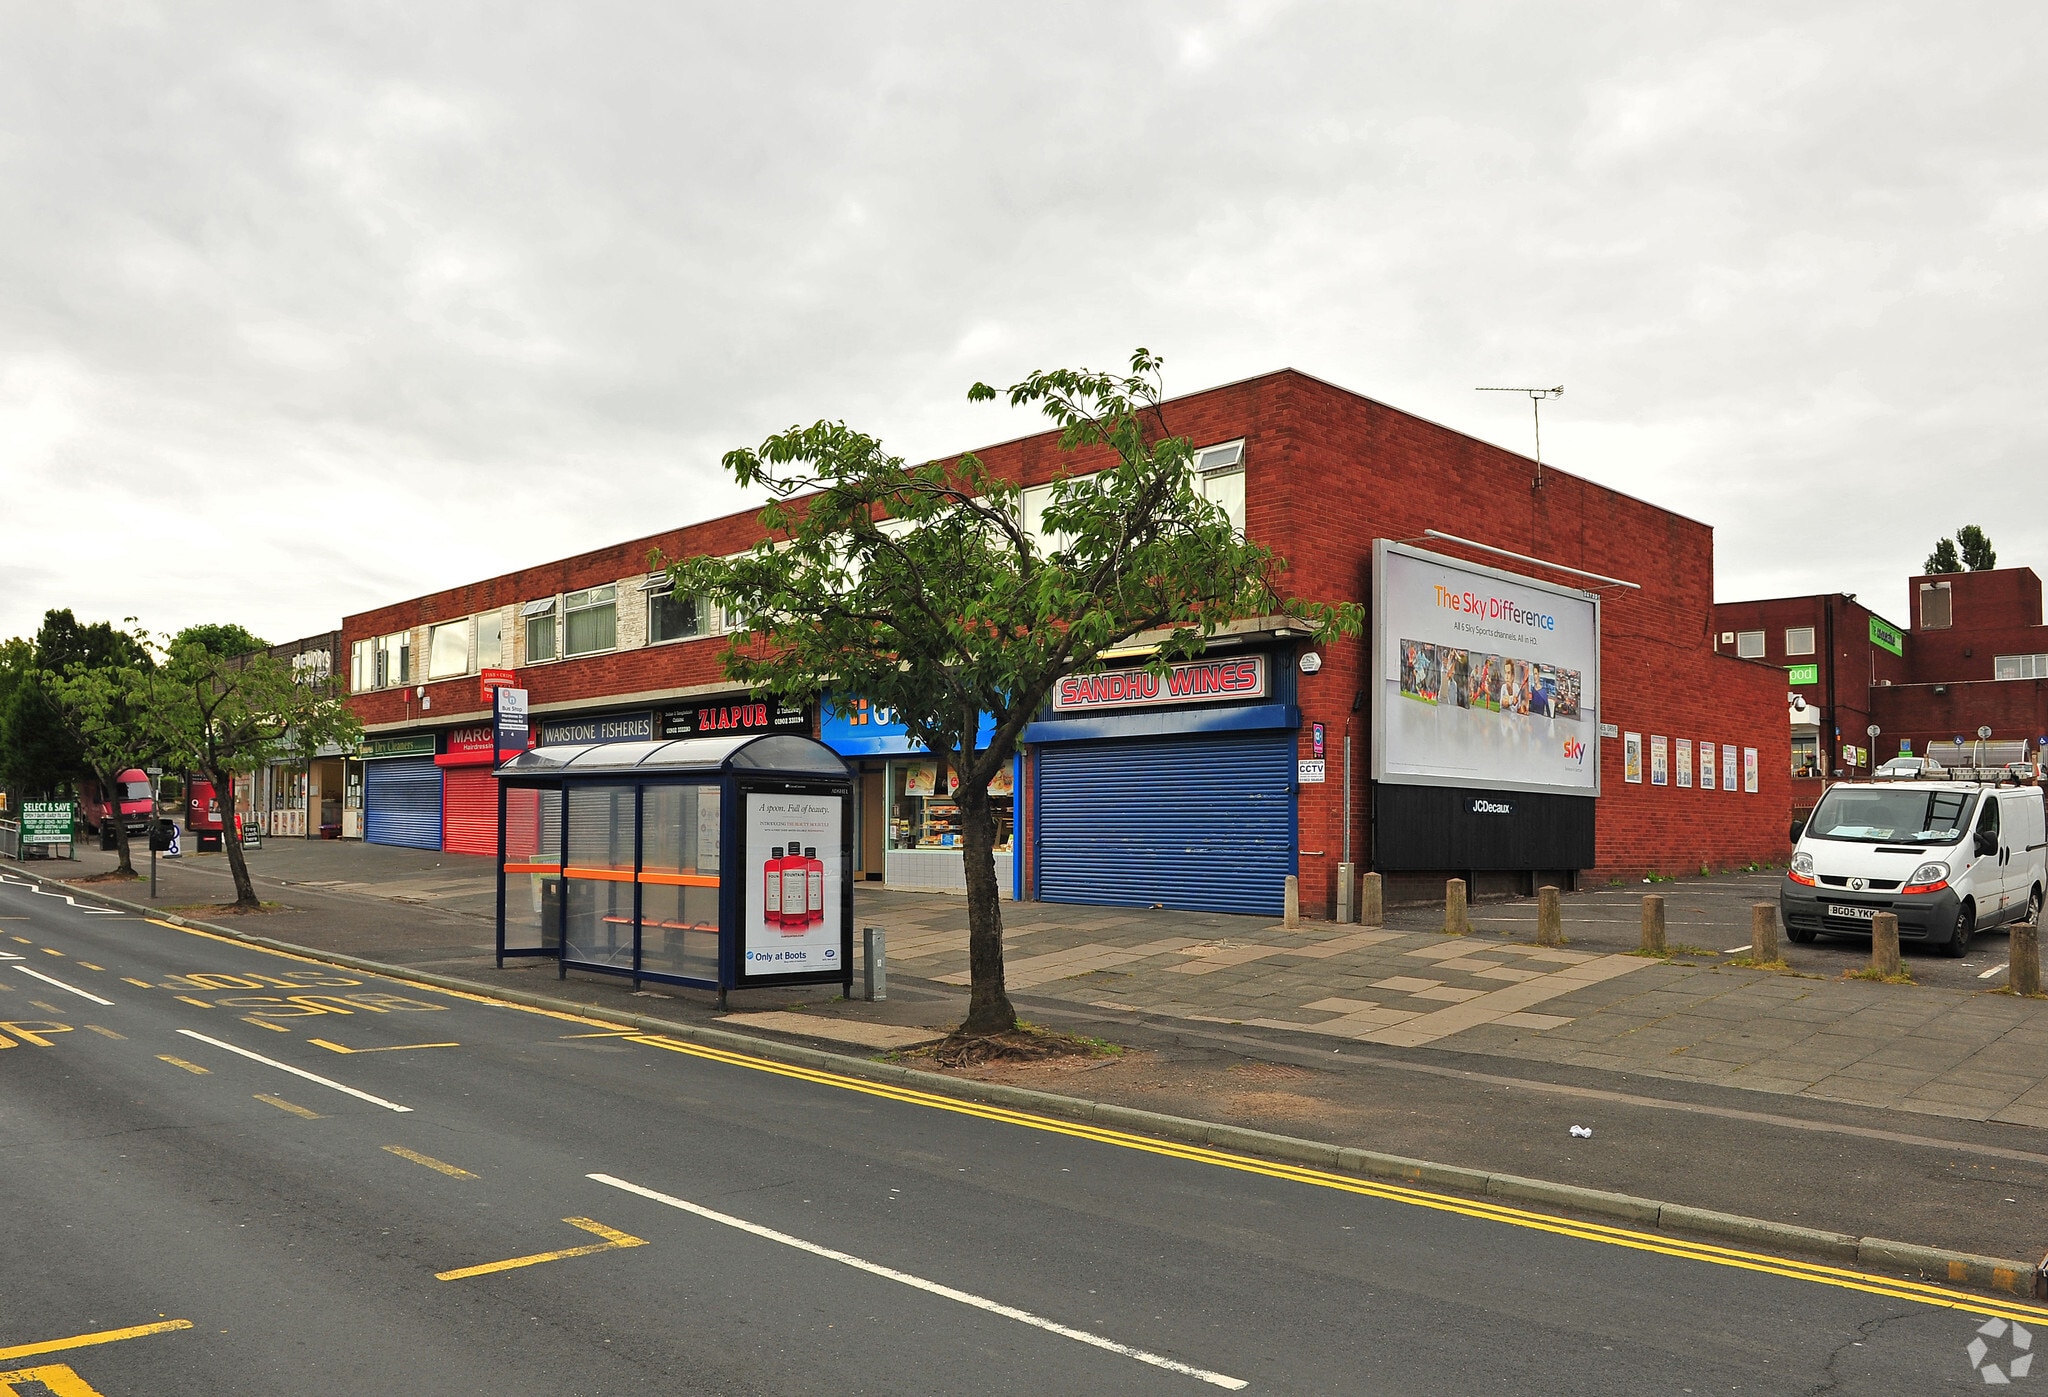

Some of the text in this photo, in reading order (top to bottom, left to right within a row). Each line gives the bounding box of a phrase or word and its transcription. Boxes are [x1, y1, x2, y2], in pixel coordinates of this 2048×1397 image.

[1433, 585, 1554, 631] The Sky Difference
[1465, 625, 1475, 635] Sky
[1476, 626, 1493, 637] Sports
[1788, 667, 1812, 680] ood
[1060, 662, 1256, 705] SANDHU WINES
[699, 704, 768, 731] ZIAPUR
[453, 727, 495, 743] MARC
[545, 720, 650, 742] WARSTONE FISHERIES
[1563, 736, 1586, 765] sky
[23, 803, 71, 811] SELECT & SAVE
[758, 804, 829, 815] A spoon. Full of beauty.
[1473, 799, 1509, 813] JCDecaux
[1832, 906, 1855, 916] BG05
[755, 951, 806, 962] Only at Boots
